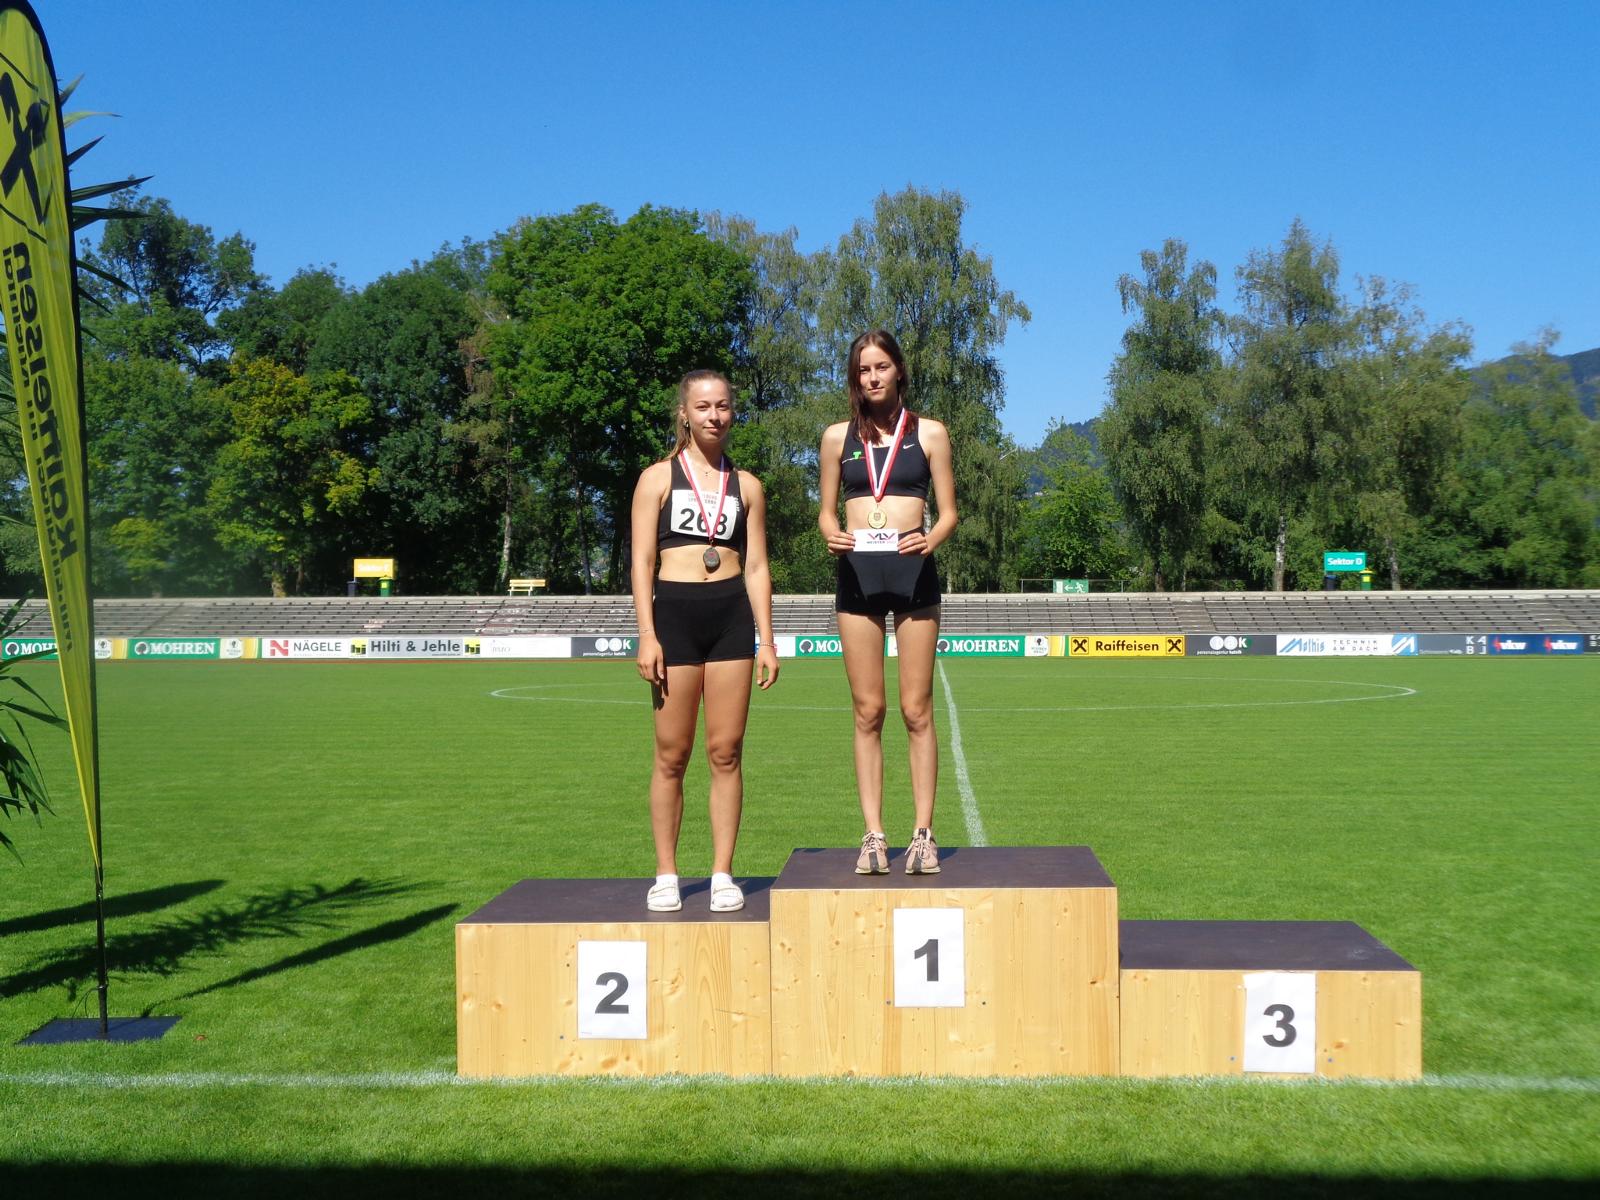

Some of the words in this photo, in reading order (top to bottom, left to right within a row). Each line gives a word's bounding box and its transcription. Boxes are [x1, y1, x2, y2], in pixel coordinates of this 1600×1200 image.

[1327, 557, 1354, 566] Sektor
[149, 642, 216, 654] MOHREN
[294, 640, 342, 652] NÄGELE
[371, 640, 400, 652] Hilti
[406, 641, 416, 652] &
[421, 640, 460, 652] Jehle
[952, 640, 1019, 652] MOHREN
[1095, 640, 1159, 652] Raiffeisen
[914, 939, 939, 982] 1
[595, 971, 630, 1014] 2
[1262, 1003, 1297, 1048] 3
